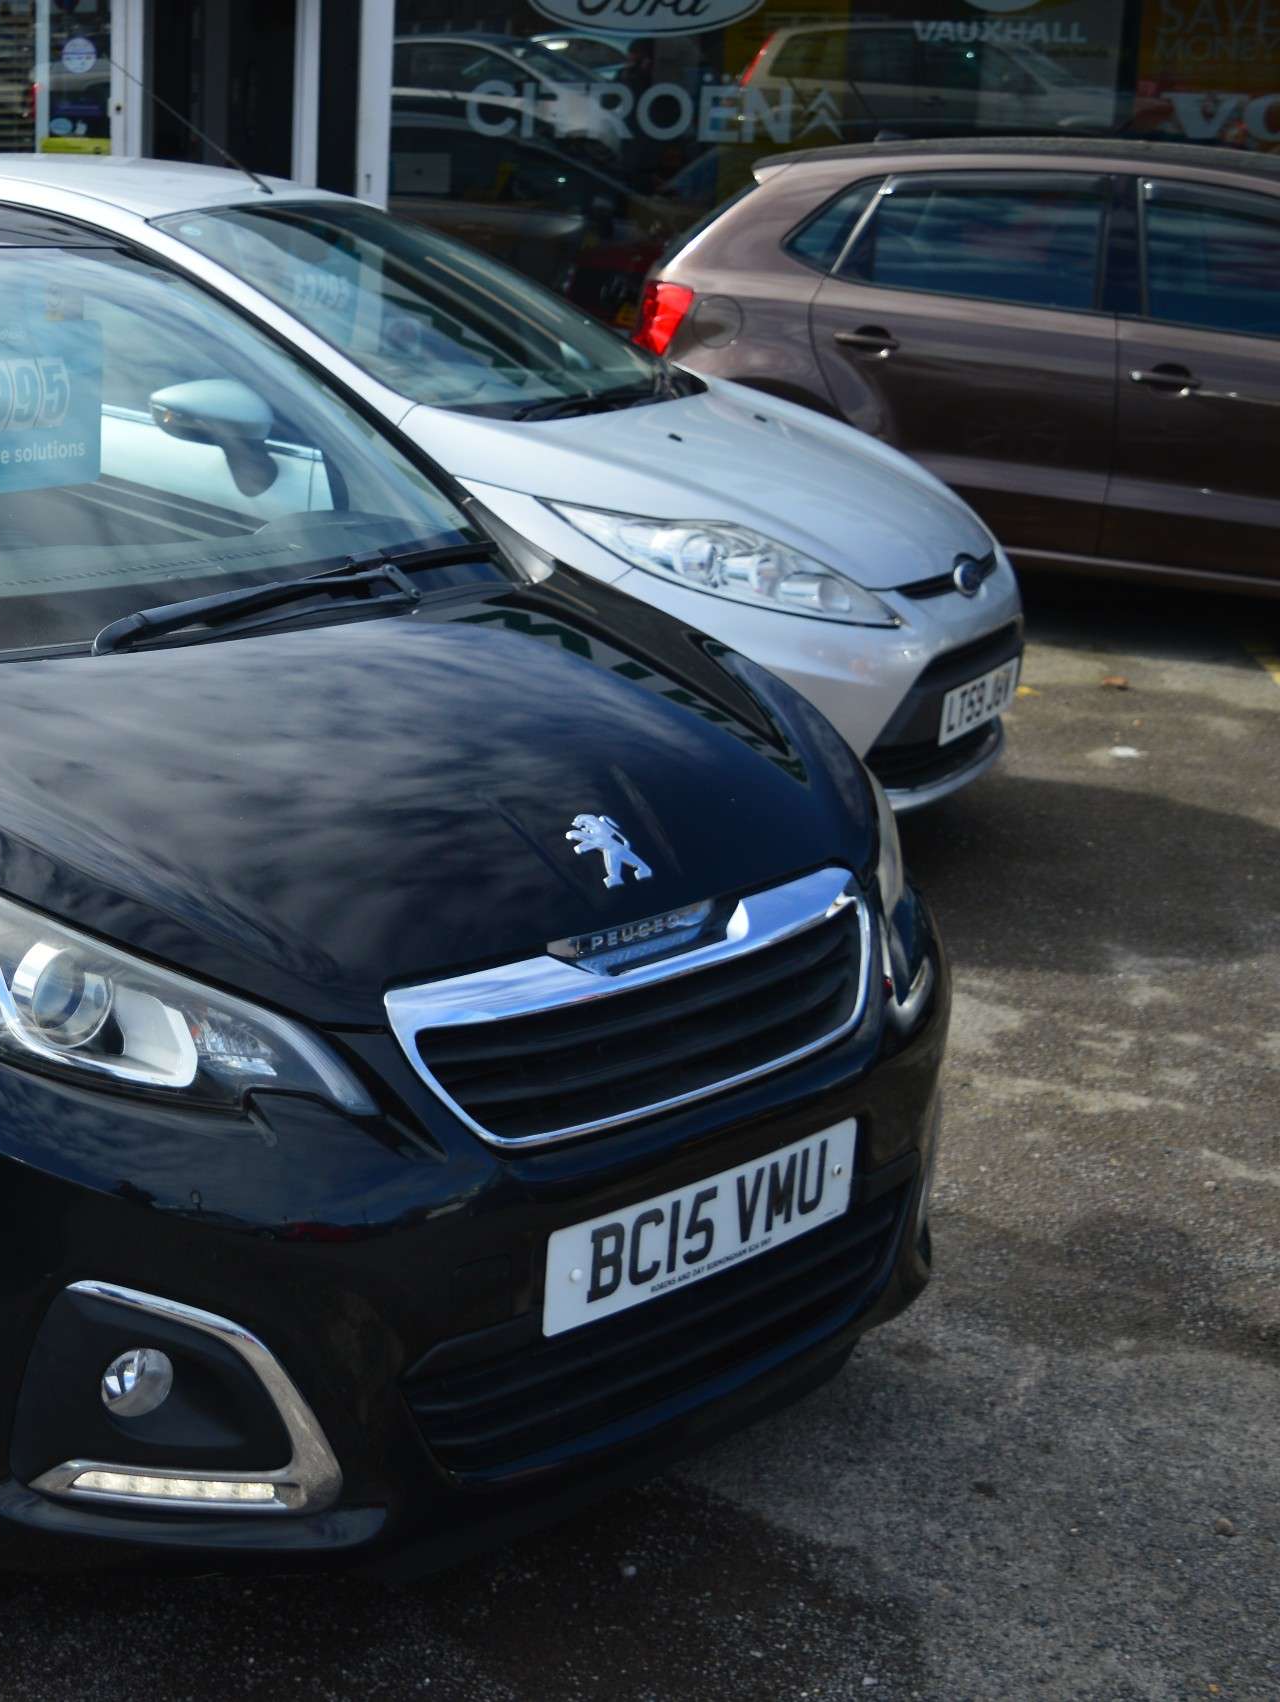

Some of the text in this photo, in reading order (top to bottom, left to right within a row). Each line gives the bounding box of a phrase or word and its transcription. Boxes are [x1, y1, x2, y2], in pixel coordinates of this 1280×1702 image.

[913, 20, 1087, 43] VAUXHALL
[465, 73, 792, 144] CITROËN
[14, 440, 86, 464] solutions
[590, 913, 682, 951] PEUGEO
[586, 1138, 829, 1304] BC15 VMU
